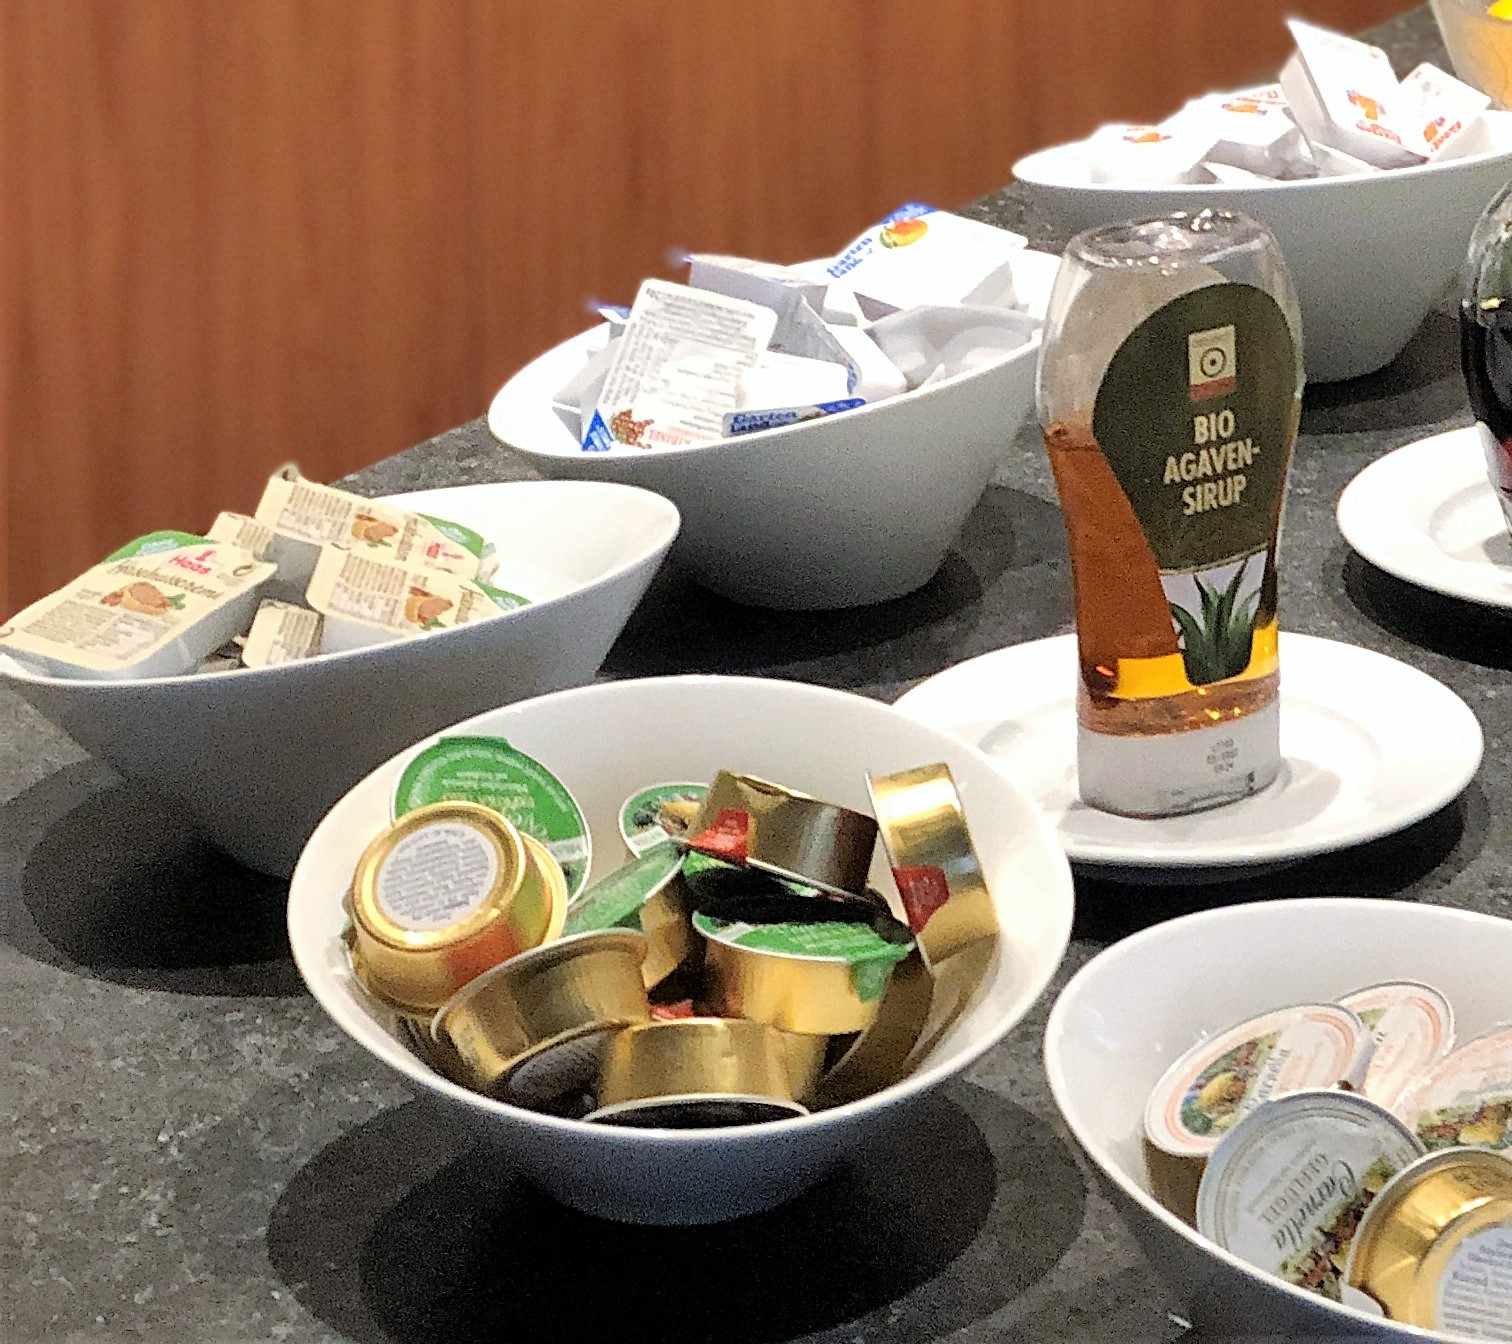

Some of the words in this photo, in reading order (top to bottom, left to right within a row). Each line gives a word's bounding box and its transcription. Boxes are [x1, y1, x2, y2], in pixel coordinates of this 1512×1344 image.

[1194, 409, 1236, 444] BIO
[1163, 437, 1261, 485] AGAVEN-
[1182, 474, 1247, 517] SIRUP
